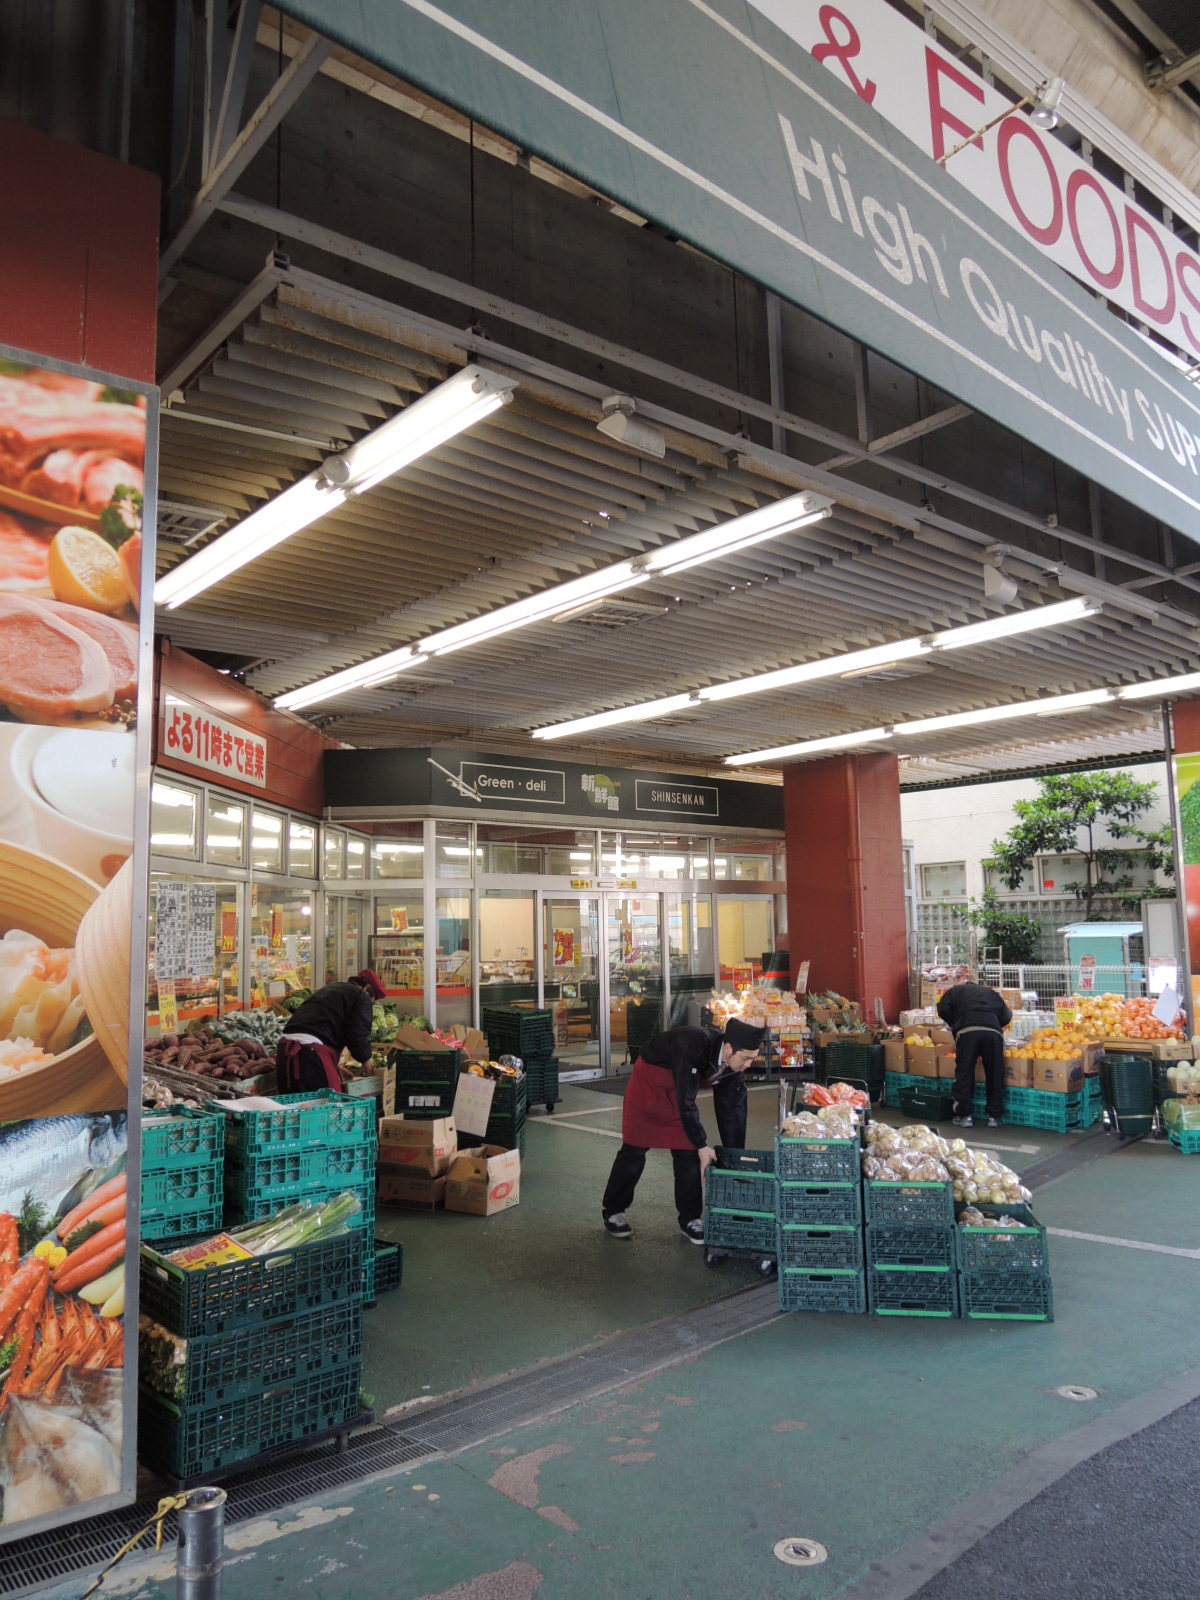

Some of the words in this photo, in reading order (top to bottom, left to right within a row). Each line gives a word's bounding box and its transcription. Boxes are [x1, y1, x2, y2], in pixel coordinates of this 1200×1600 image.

[778, 112, 950, 299] High
[959, 257, 1134, 441] Quality
[166, 706, 266, 781] よる11時まで営業
[477, 774, 515, 789] Green
[525, 779, 547, 792] deli
[581, 773, 620, 811] 新鮮館
[651, 790, 705, 806] SHINSENKAN
